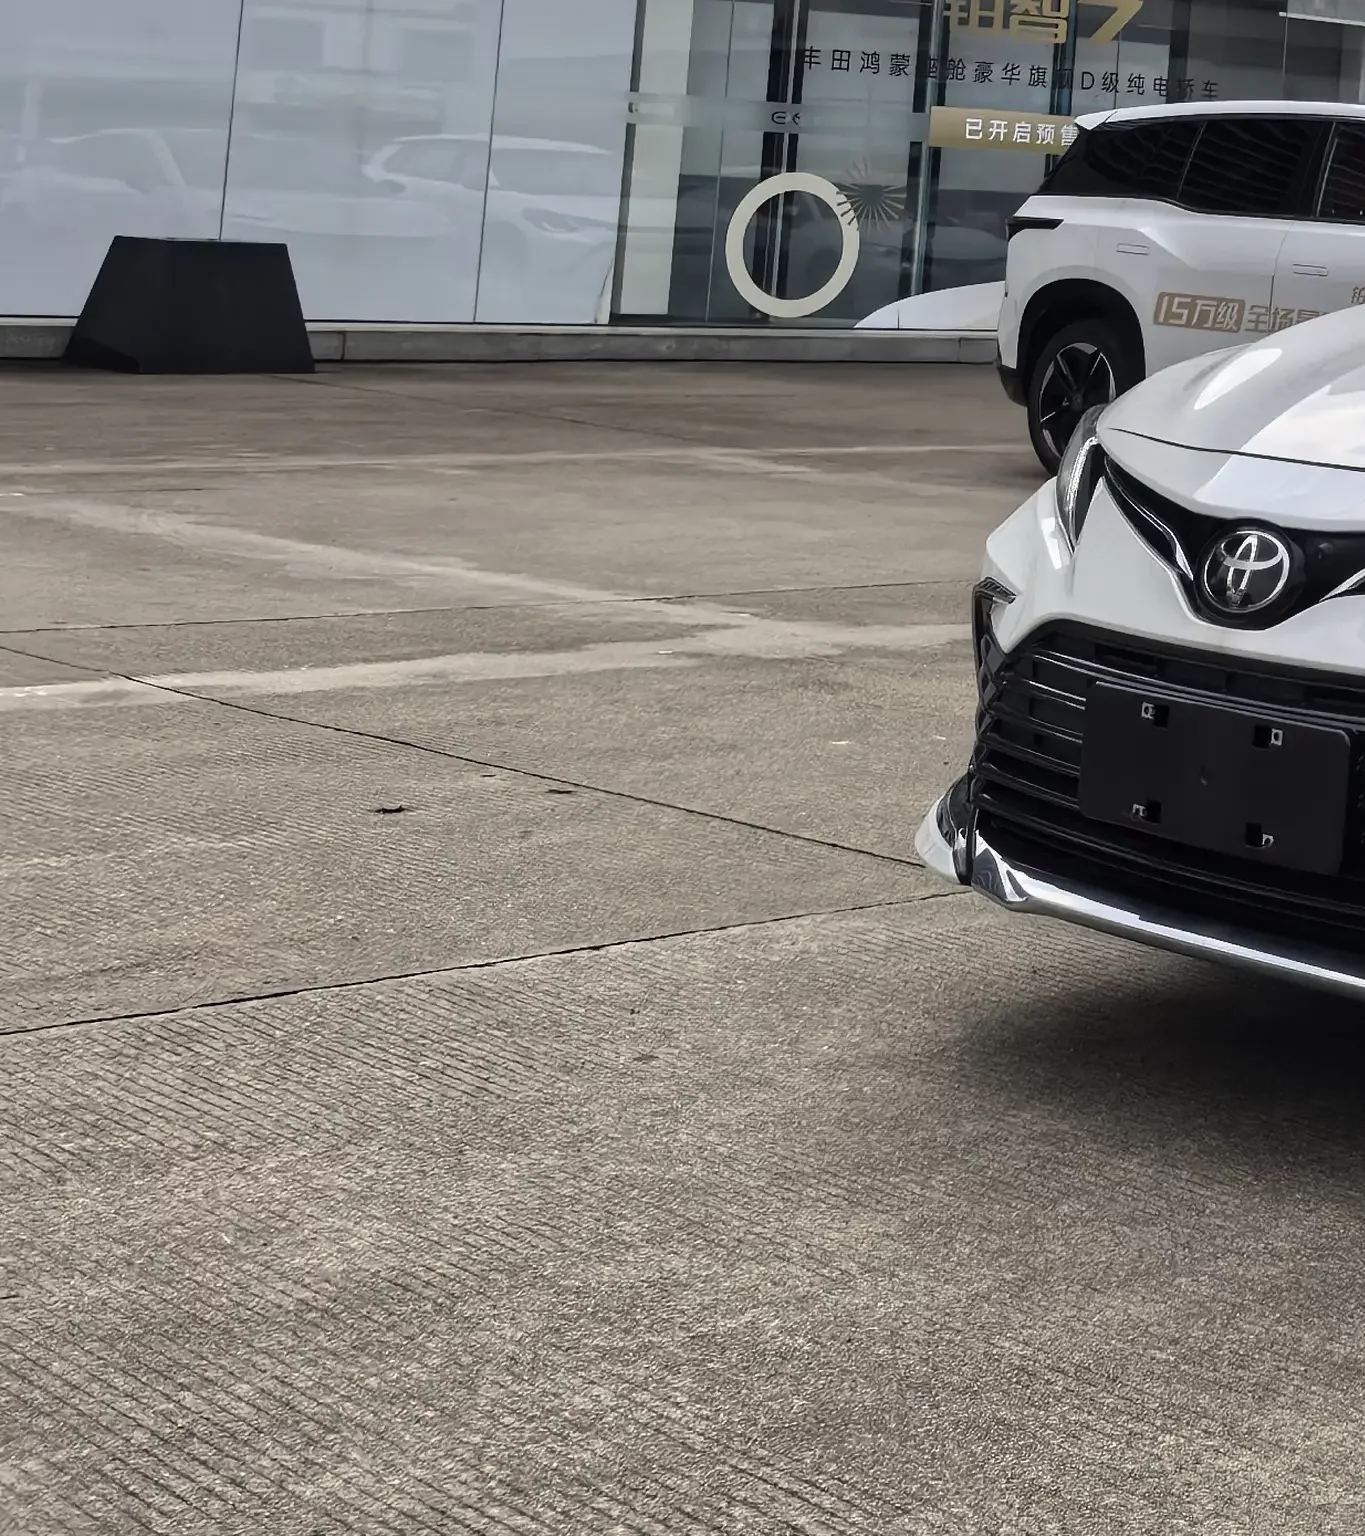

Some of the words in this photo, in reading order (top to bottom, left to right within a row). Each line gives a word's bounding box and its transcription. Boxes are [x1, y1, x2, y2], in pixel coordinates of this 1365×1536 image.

[964, 117, 1079, 146] 已开启预售
